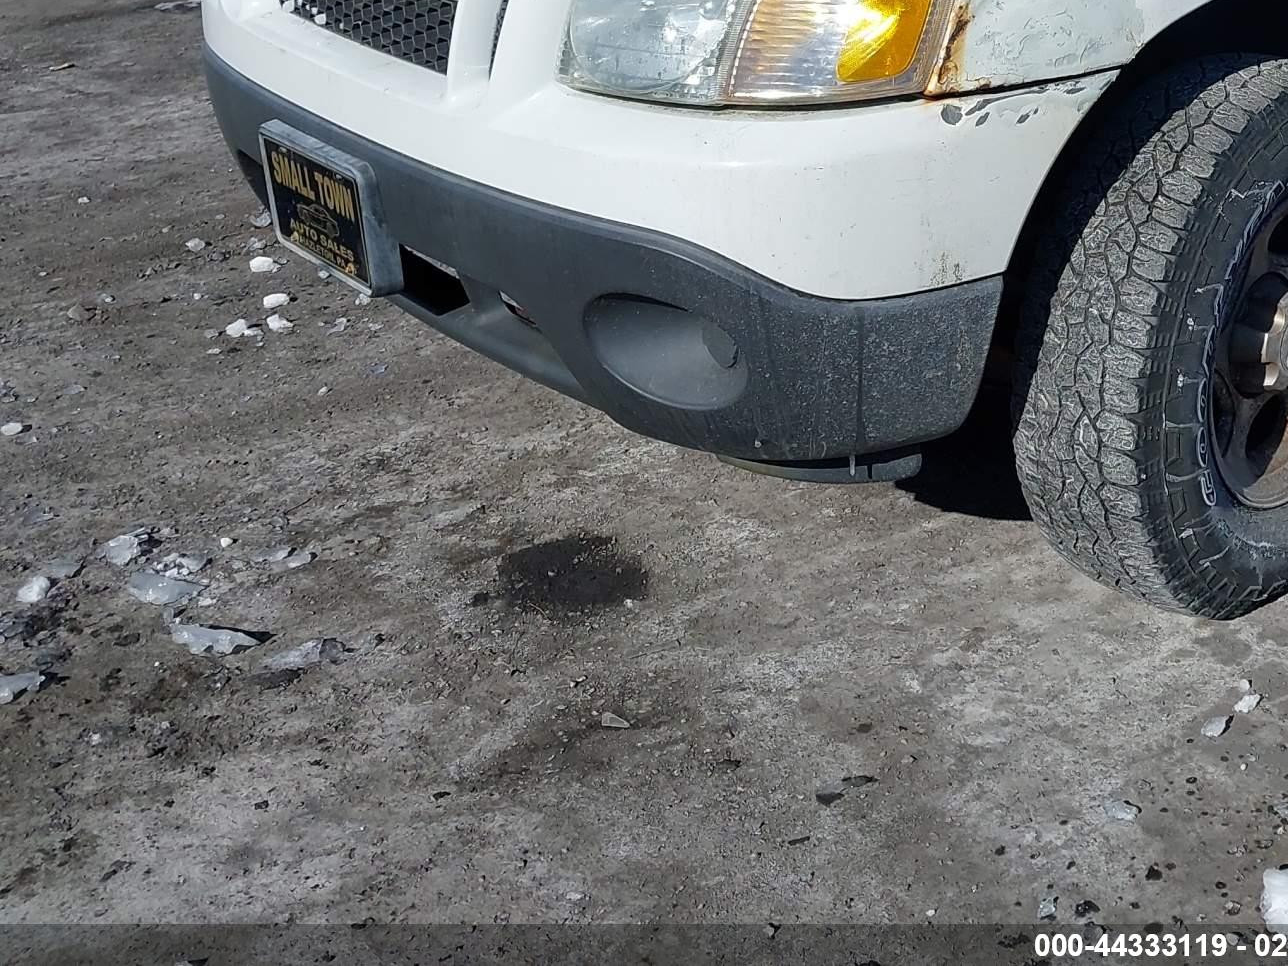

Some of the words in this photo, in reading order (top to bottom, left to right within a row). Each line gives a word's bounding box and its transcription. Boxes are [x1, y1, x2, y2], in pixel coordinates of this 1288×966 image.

[271, 150, 316, 201] SMALL
[314, 170, 356, 223] TOWN
[290, 217, 318, 242] AUTO
[319, 234, 354, 262] SALES
[336, 255, 346, 268] PA
